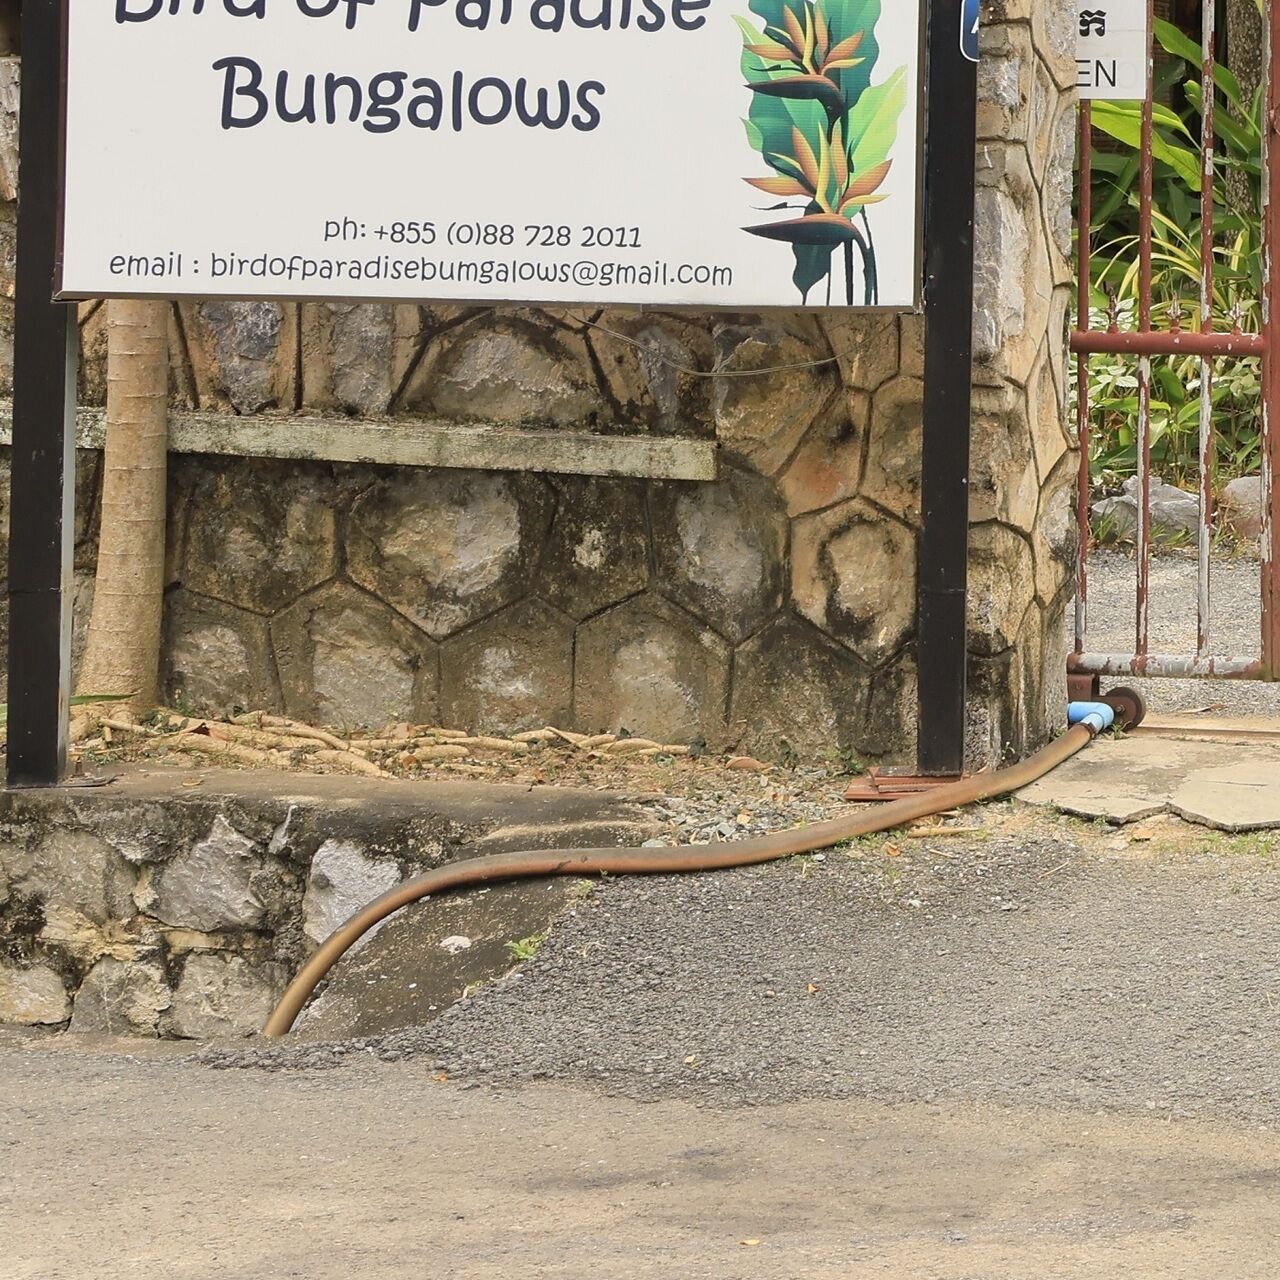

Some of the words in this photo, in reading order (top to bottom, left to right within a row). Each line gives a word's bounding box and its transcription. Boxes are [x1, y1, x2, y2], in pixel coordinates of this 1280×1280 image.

[1074, 59, 1117, 88] EN
[212, 56, 606, 134] Bungalows
[324, 216, 366, 242] ph:
[374, 221, 436, 245] +855
[447, 221, 515, 246] (0)88
[524, 225, 571, 247] 728
[580, 225, 642, 248] 2011
[109, 252, 182, 277] email
[211, 252, 733, 287] birdofparadisebumgalows@gmail.com
